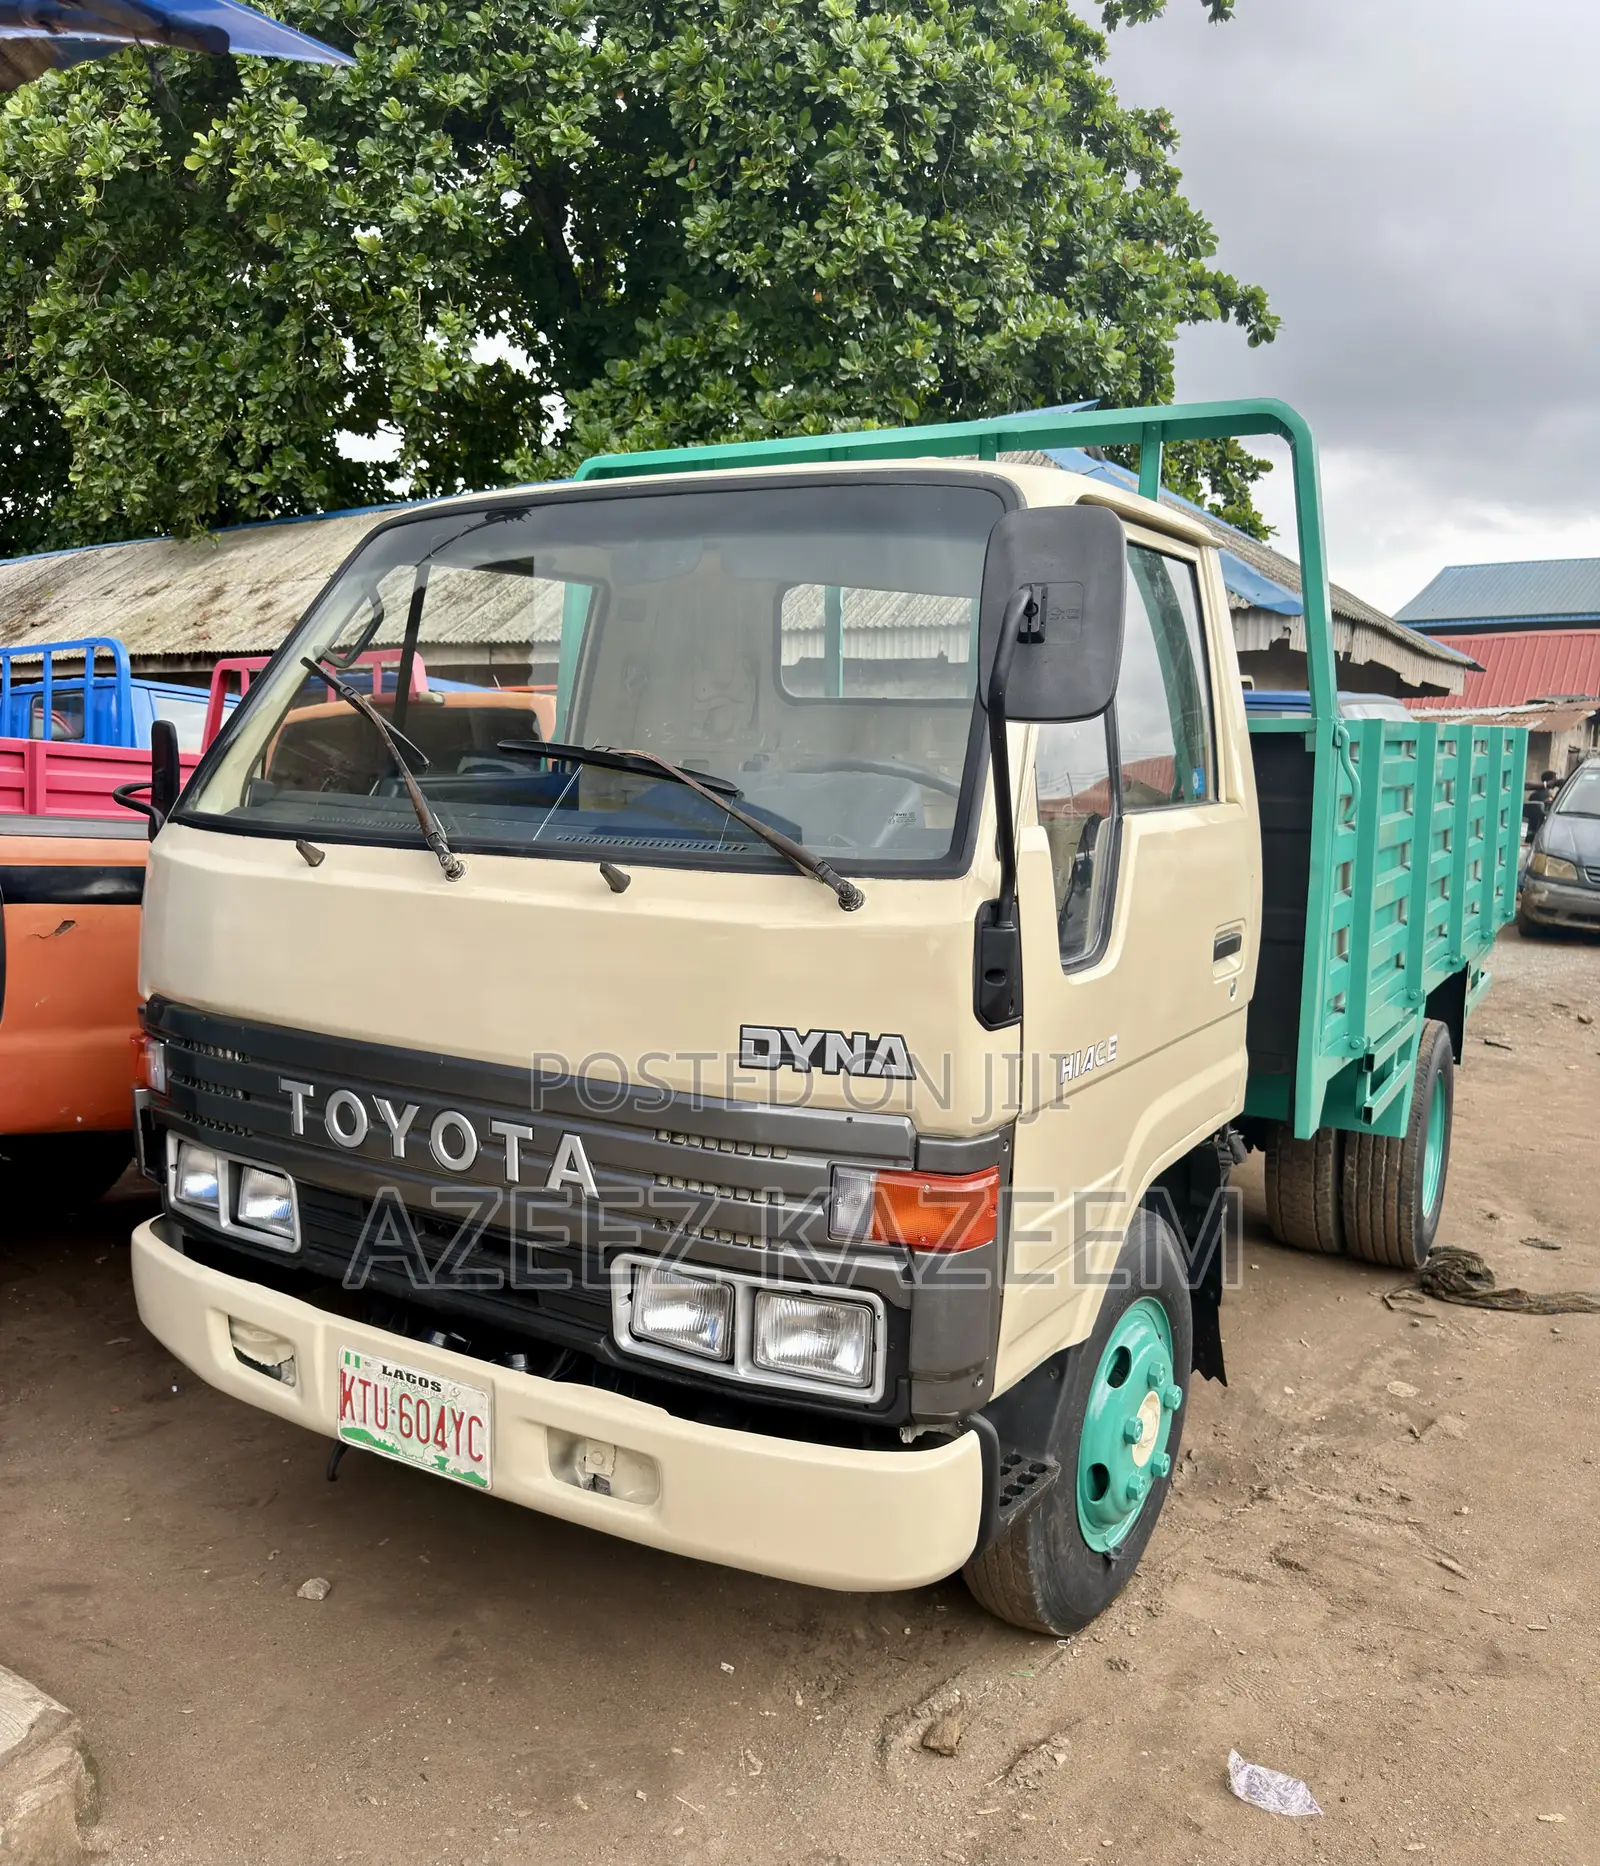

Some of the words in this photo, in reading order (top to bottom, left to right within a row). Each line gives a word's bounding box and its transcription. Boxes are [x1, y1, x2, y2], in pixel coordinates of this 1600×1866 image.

[739, 1024, 916, 1080] DYNA
[1060, 1034, 1118, 1085] HIACE
[279, 1076, 600, 1200] TOYOTA
[382, 1364, 442, 1393] LAGOS
